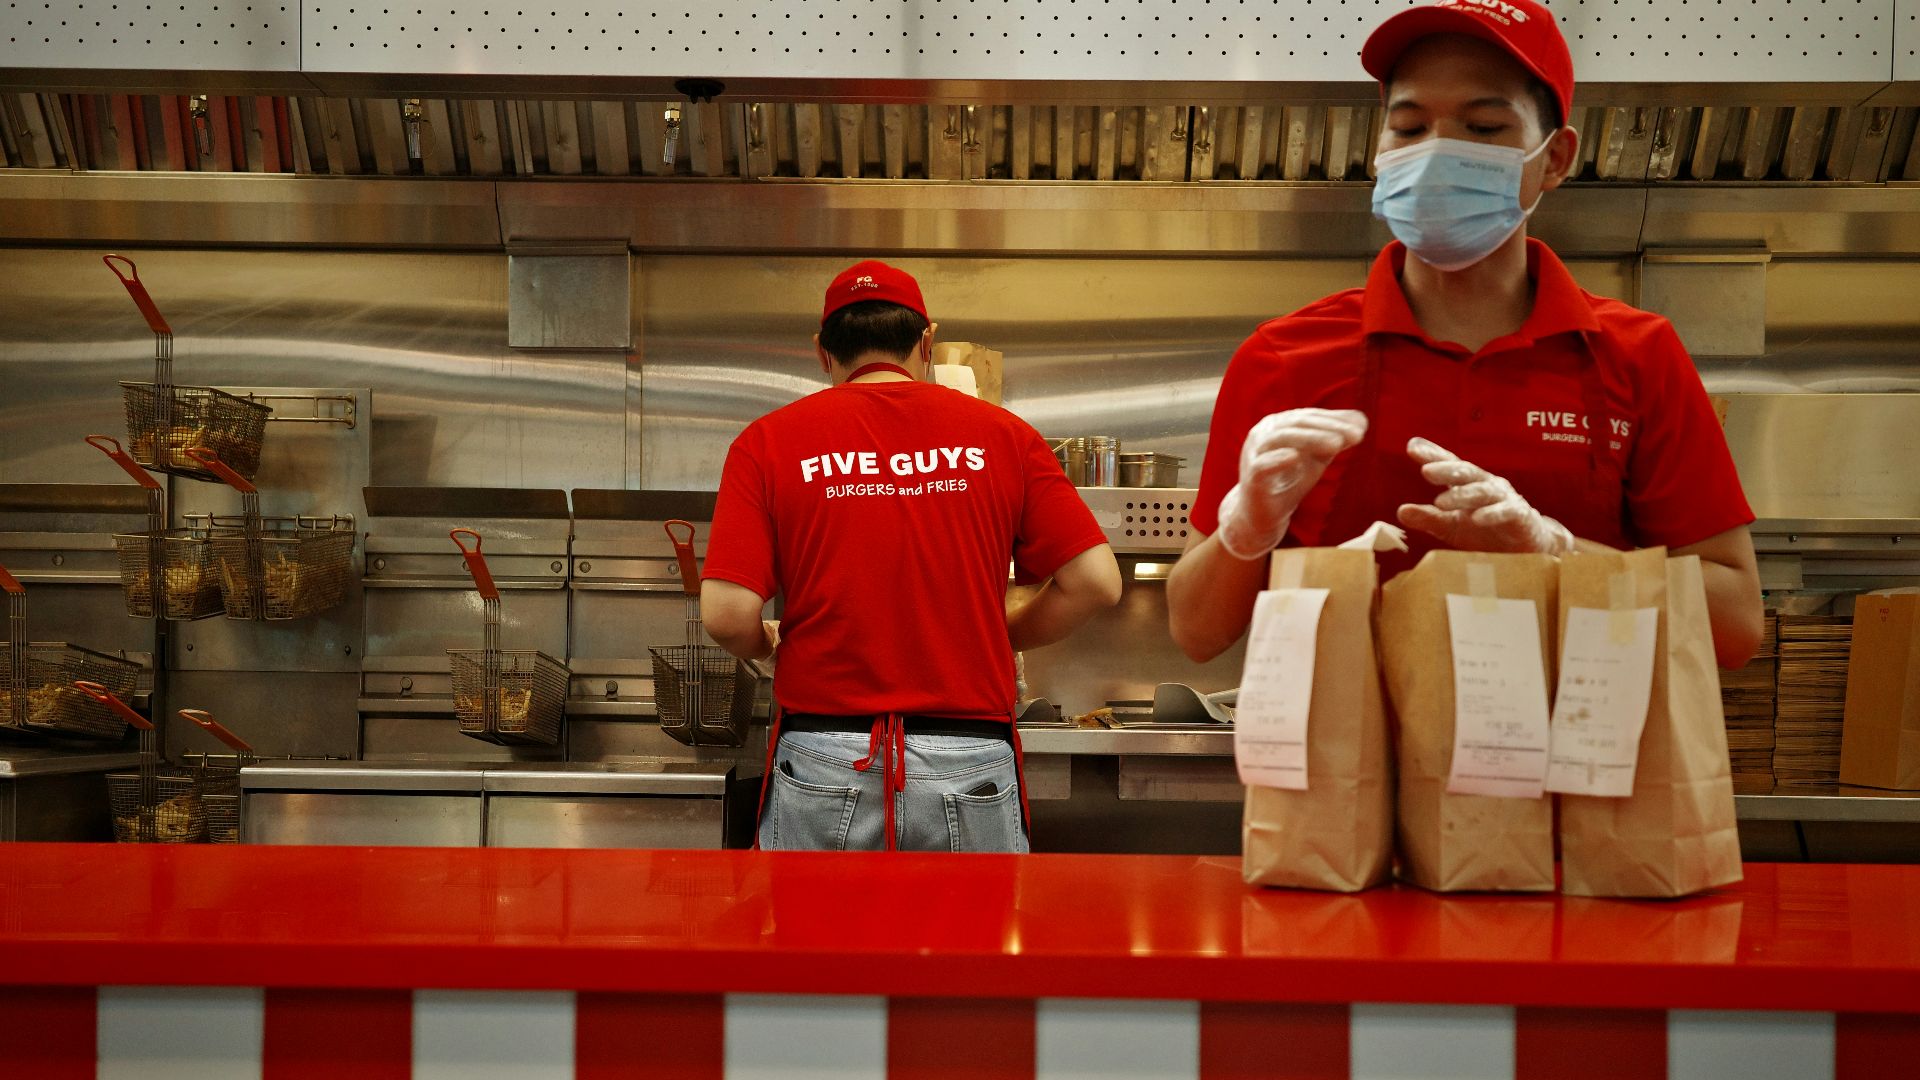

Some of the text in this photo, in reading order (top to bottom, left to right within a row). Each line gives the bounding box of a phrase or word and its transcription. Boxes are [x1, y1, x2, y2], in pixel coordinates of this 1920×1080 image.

[1526, 411, 1577, 428] FIVE
[800, 447, 985, 483] FIVE GUYS
[826, 479, 968, 499] BURGERS and FRIES
